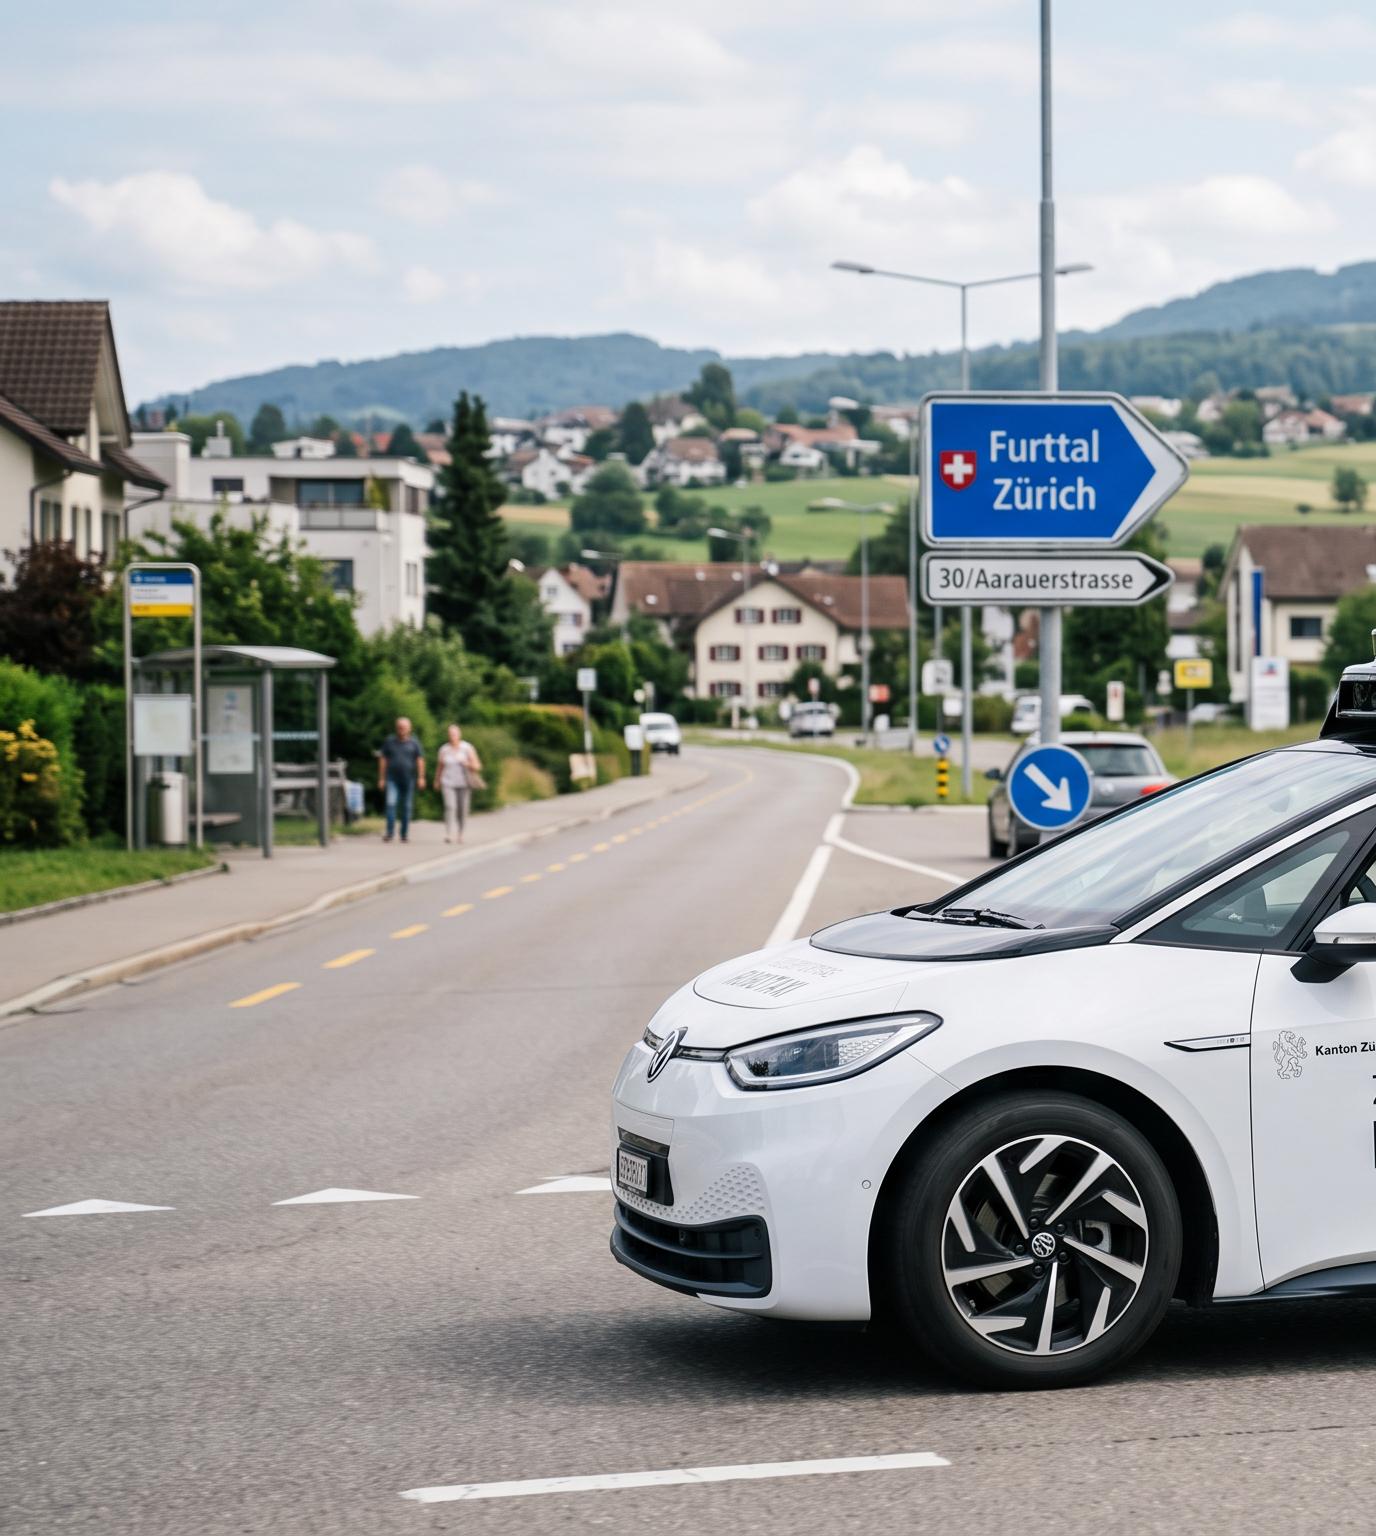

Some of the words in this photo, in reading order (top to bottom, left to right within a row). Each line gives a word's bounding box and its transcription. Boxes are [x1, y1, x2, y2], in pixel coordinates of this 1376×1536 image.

[990, 429, 1099, 463] Furttal
[992, 476, 1096, 511] Zürich
[939, 567, 1133, 590] 30/Aarauerstrasse
[1315, 1044, 1358, 1056] Kanton
